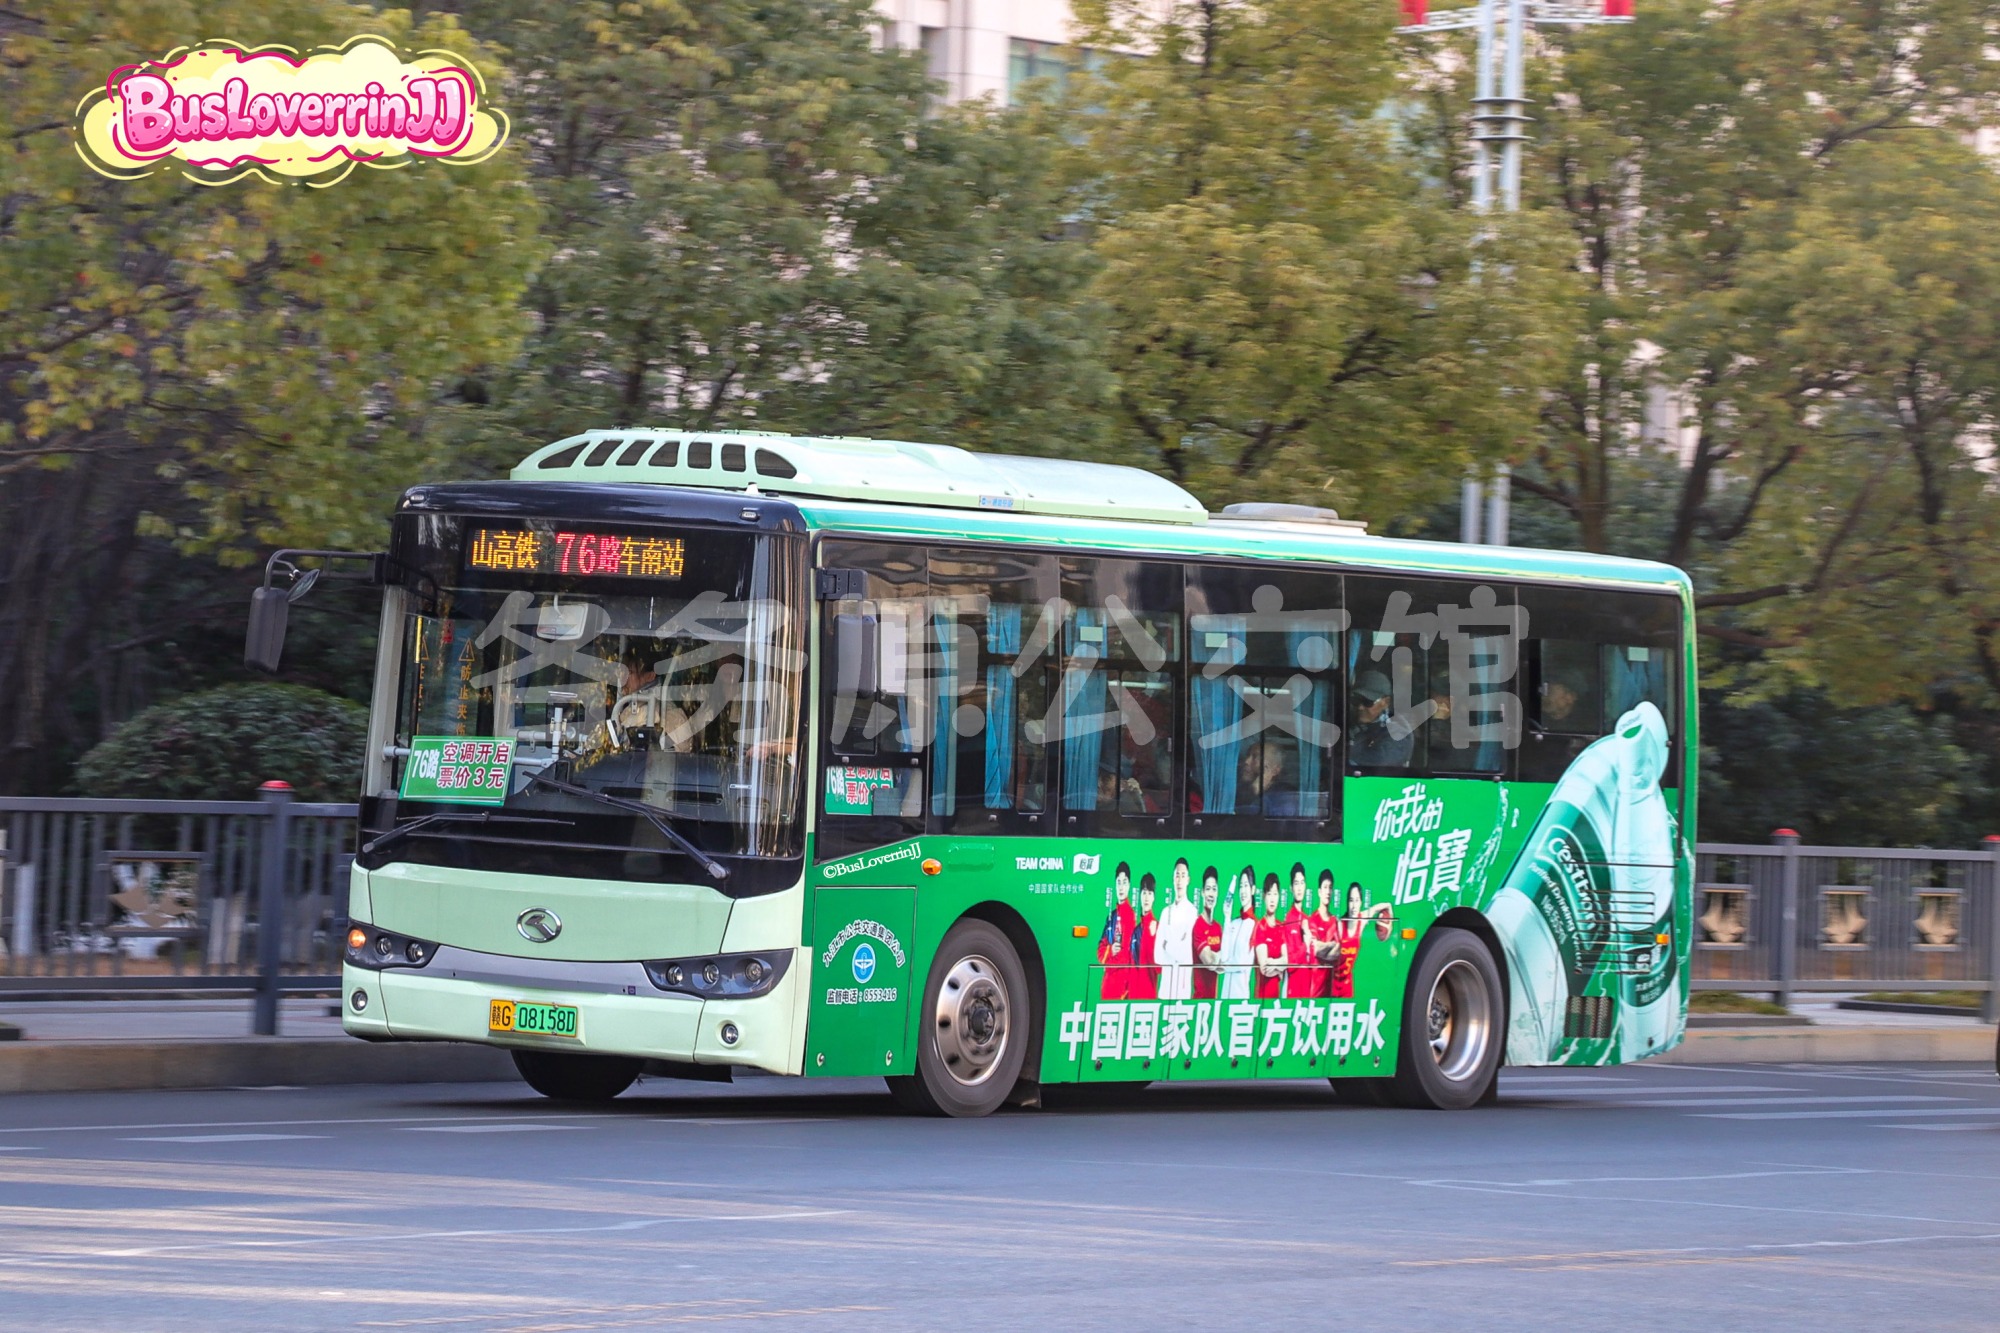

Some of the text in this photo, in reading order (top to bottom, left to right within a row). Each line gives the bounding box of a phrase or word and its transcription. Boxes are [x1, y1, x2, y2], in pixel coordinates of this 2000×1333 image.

[472, 529, 685, 576] 山高铁 76路 车南站
[412, 748, 440, 780] 76路
[441, 743, 511, 765] 空调开启
[436, 767, 506, 789] 票价3元
[1373, 782, 1443, 843] 你我的
[1015, 857, 1064, 870] TEAM CHINA
[1059, 999, 1387, 1062] 中国国家队官方饮用水
